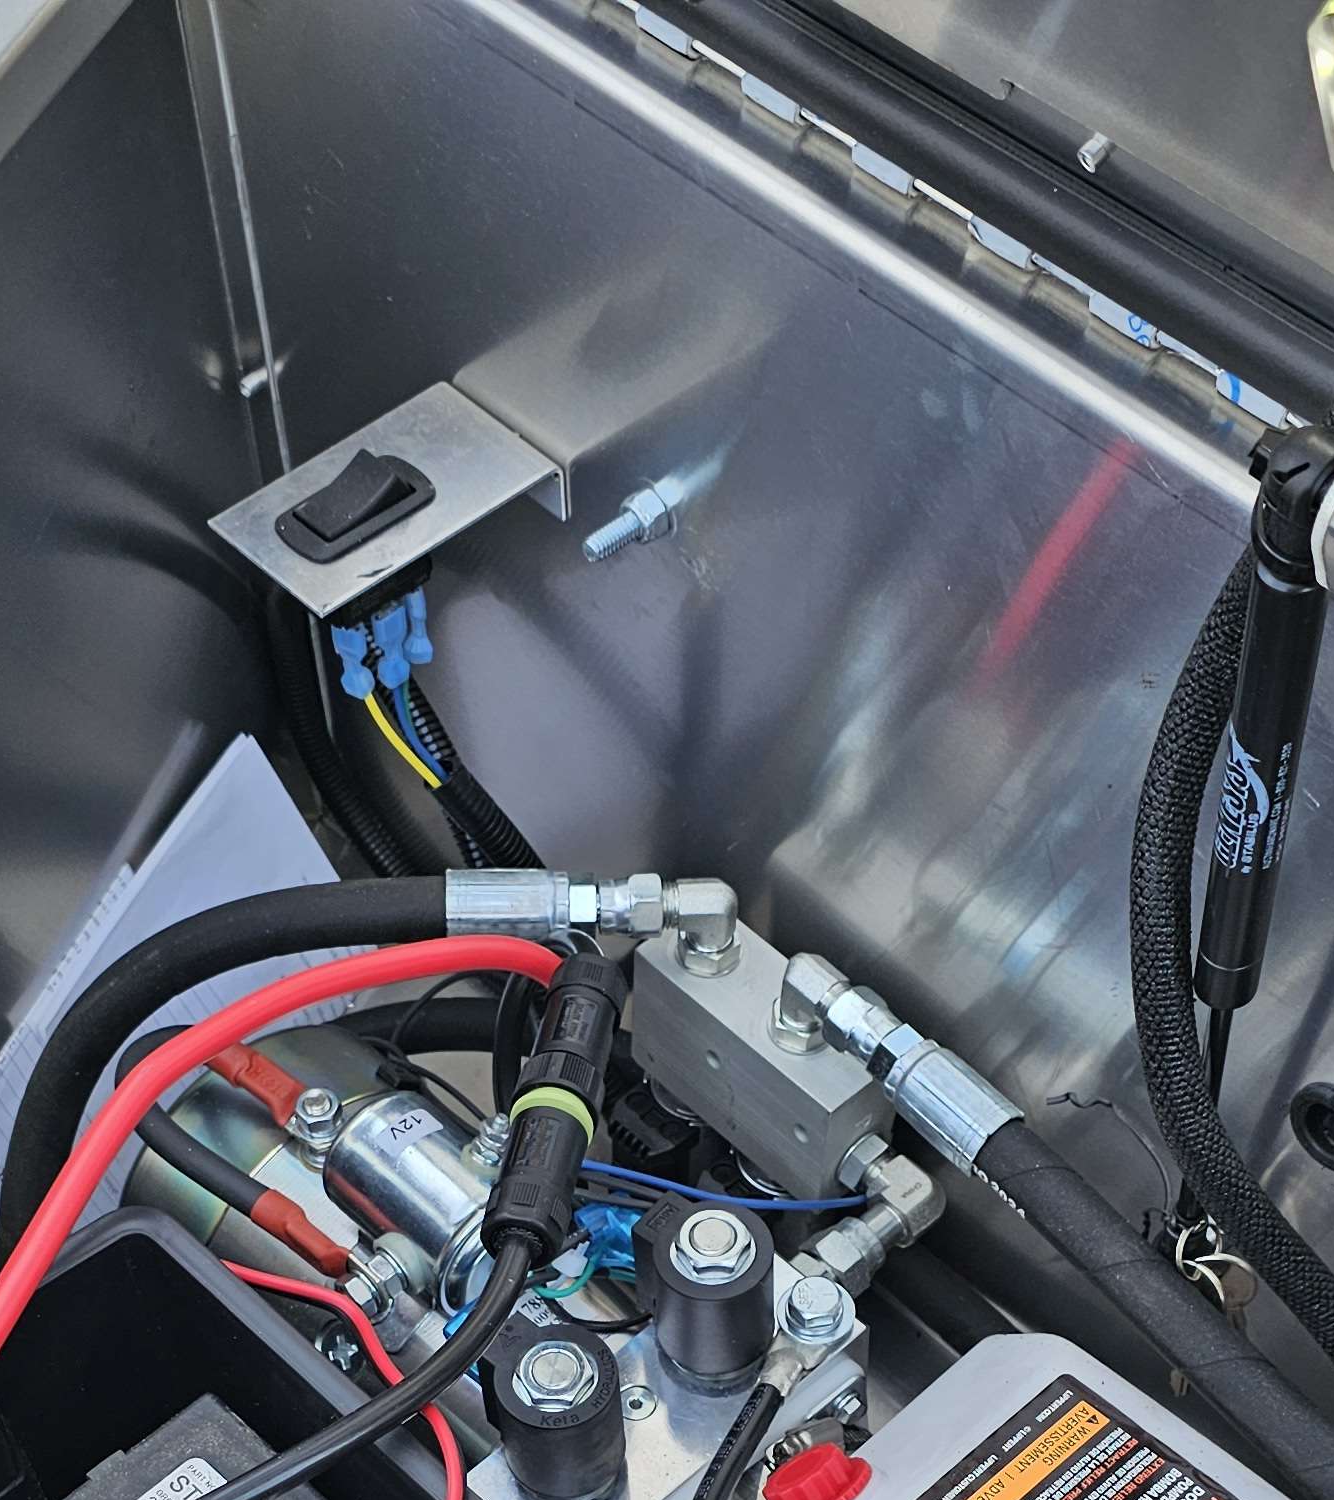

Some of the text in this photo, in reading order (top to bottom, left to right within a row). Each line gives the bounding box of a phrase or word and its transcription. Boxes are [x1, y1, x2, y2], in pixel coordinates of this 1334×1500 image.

[388, 1112, 425, 1140] 12V
[1011, 1404, 1091, 1474] AVERTISSEMENT
[1040, 1423, 1091, 1467] WARNING
[1144, 1466, 1183, 1500] BOMBA
